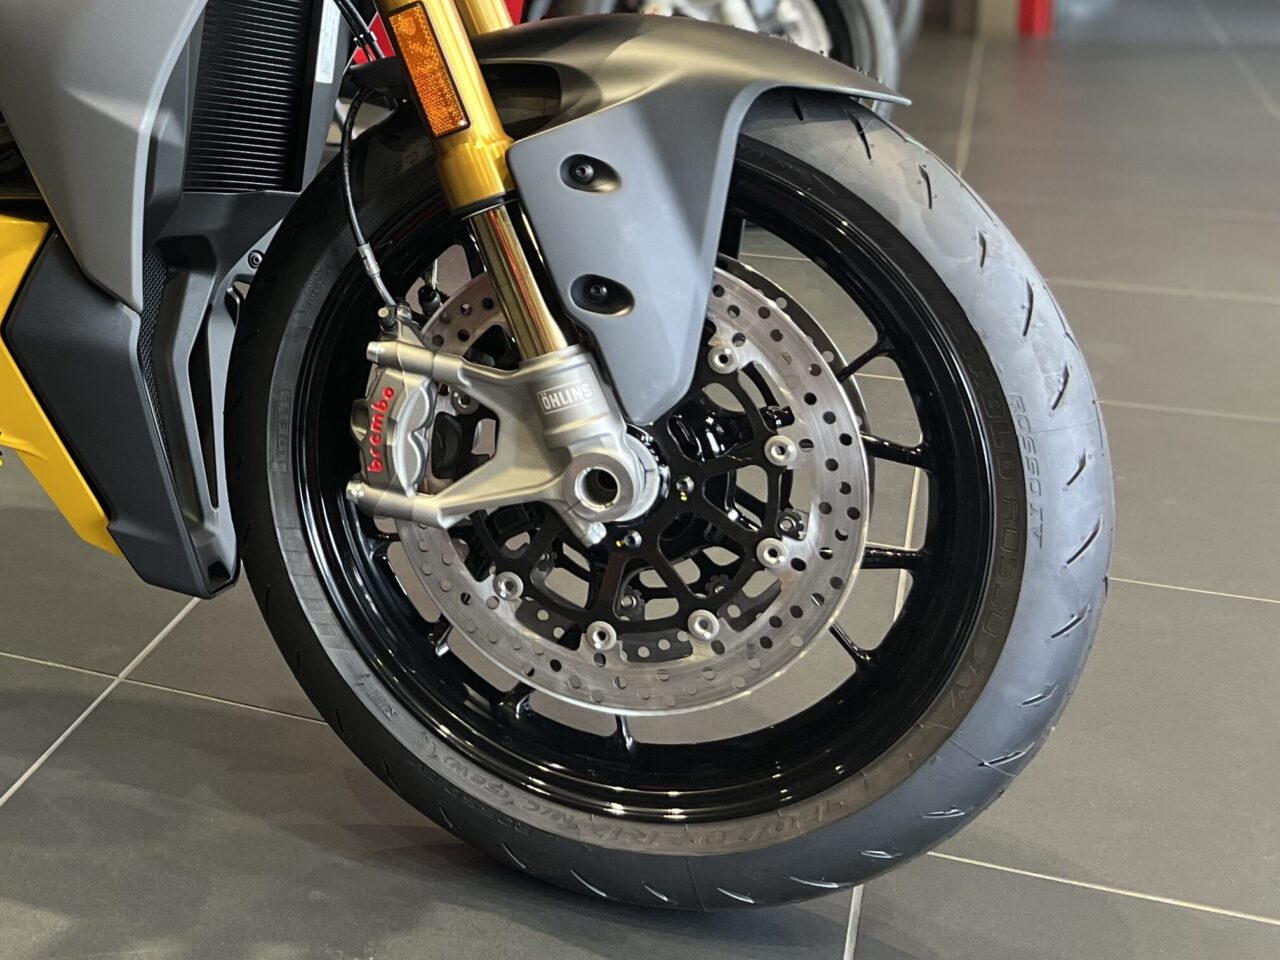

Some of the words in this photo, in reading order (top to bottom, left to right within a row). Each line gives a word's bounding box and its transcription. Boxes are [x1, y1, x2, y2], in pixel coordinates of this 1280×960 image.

[367, 386, 394, 473] brembo
[540, 383, 593, 410] ÖHLINS
[1007, 394, 1042, 496] ROSSO
